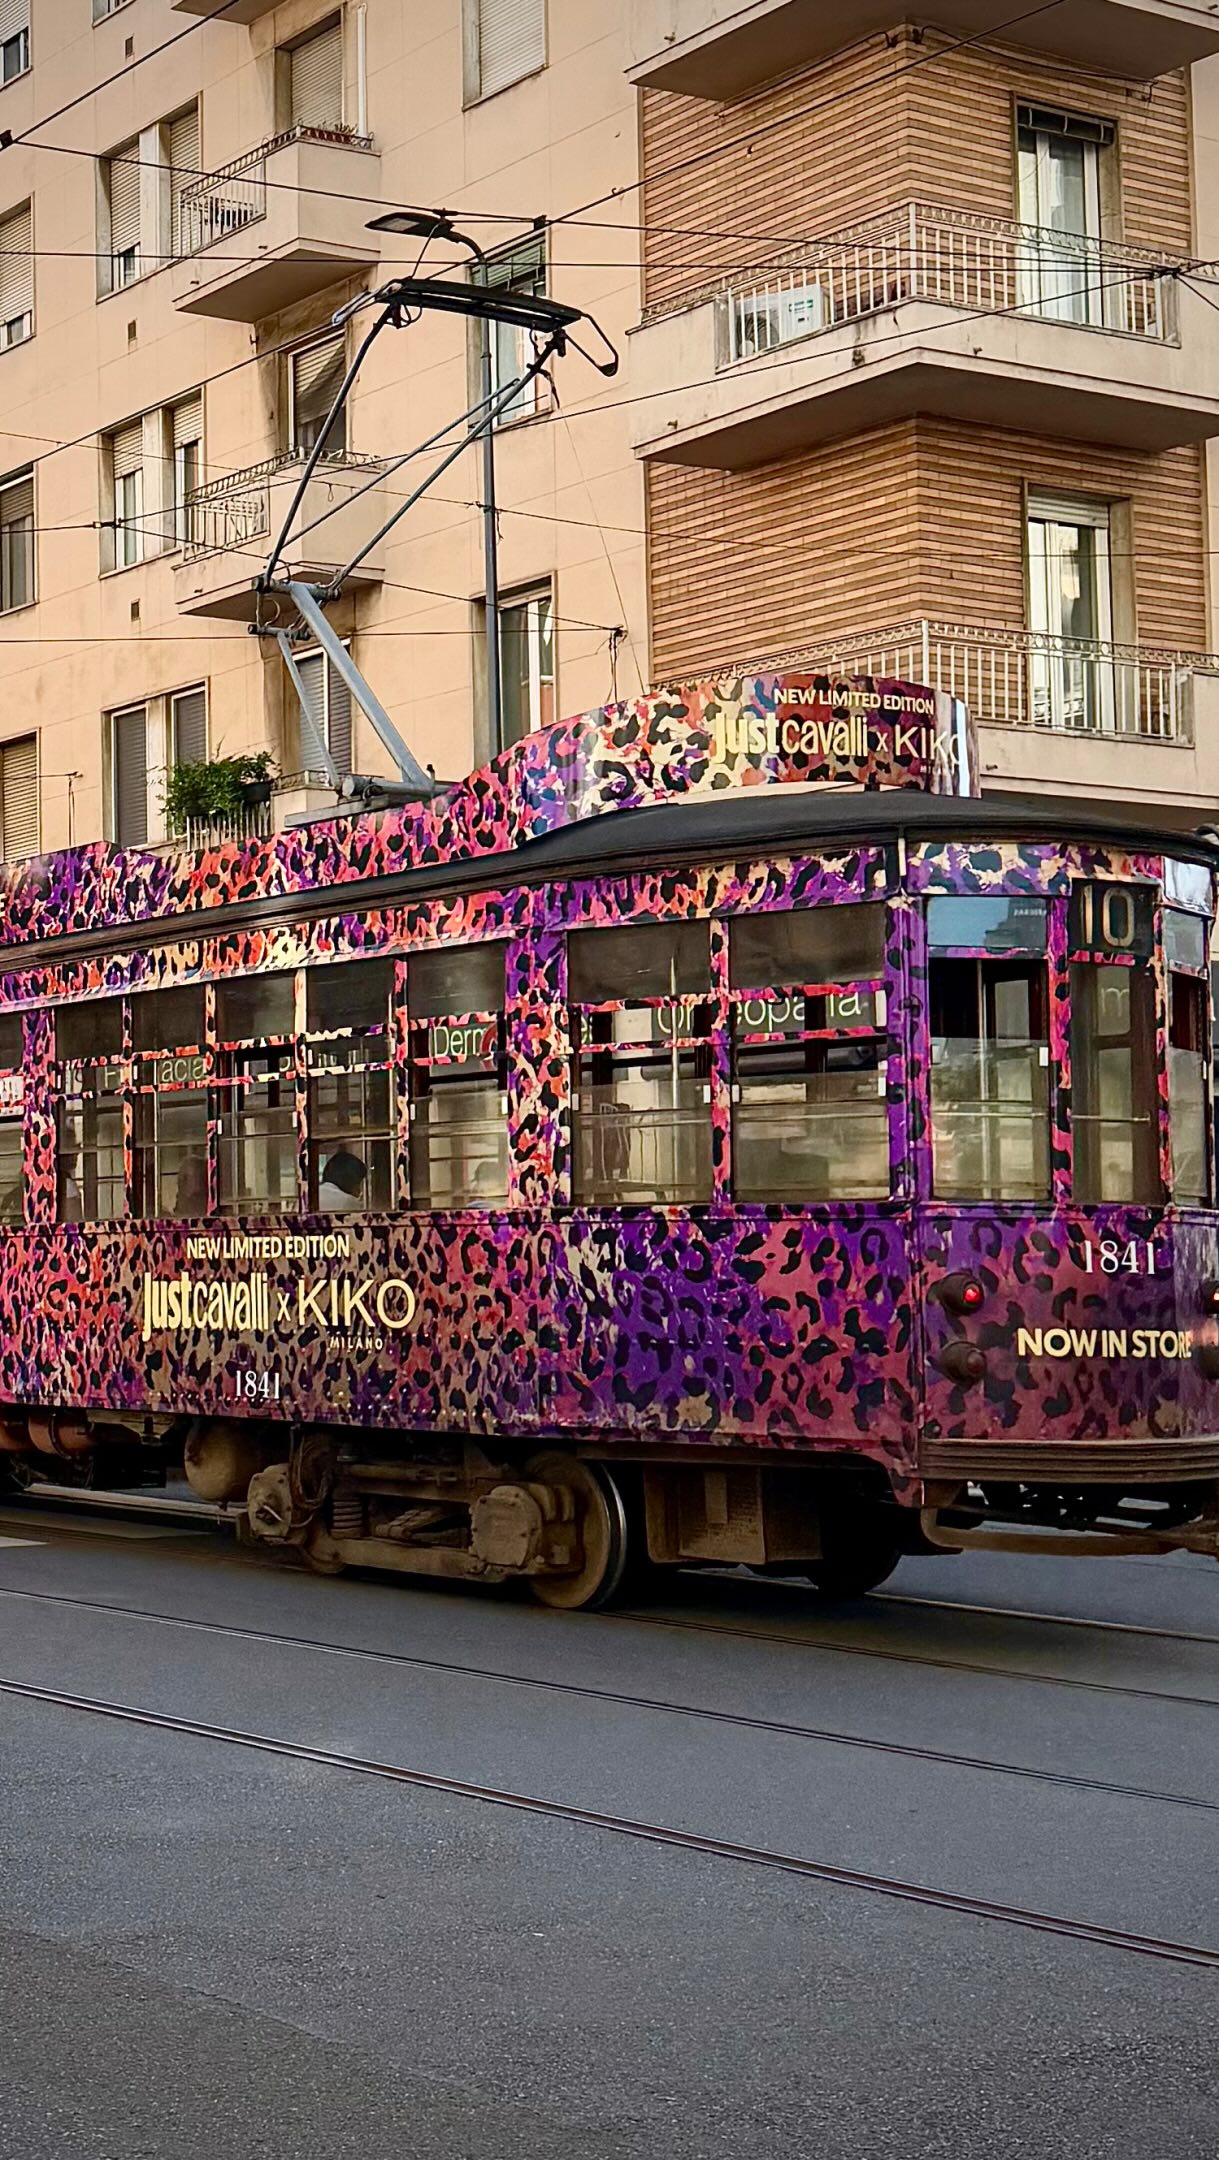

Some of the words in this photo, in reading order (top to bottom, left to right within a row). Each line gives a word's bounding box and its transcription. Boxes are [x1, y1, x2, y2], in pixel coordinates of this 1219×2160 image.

[774, 688, 818, 706] NEW
[819, 689, 881, 709] LIMITED
[883, 692, 935, 715] EDITION
[1081, 884, 1136, 947] 10
[186, 1237, 222, 1259] NEW
[223, 1236, 283, 1259] LIMITED
[285, 1234, 350, 1258] EDITION
[1084, 1240, 1156, 1275] 1841
[298, 1275, 416, 1329] KIKO
[328, 1336, 384, 1351] MILANO
[1017, 1327, 1097, 1358] NOW
[1101, 1328, 1128, 1359] IN
[235, 1369, 280, 1400] 1841
